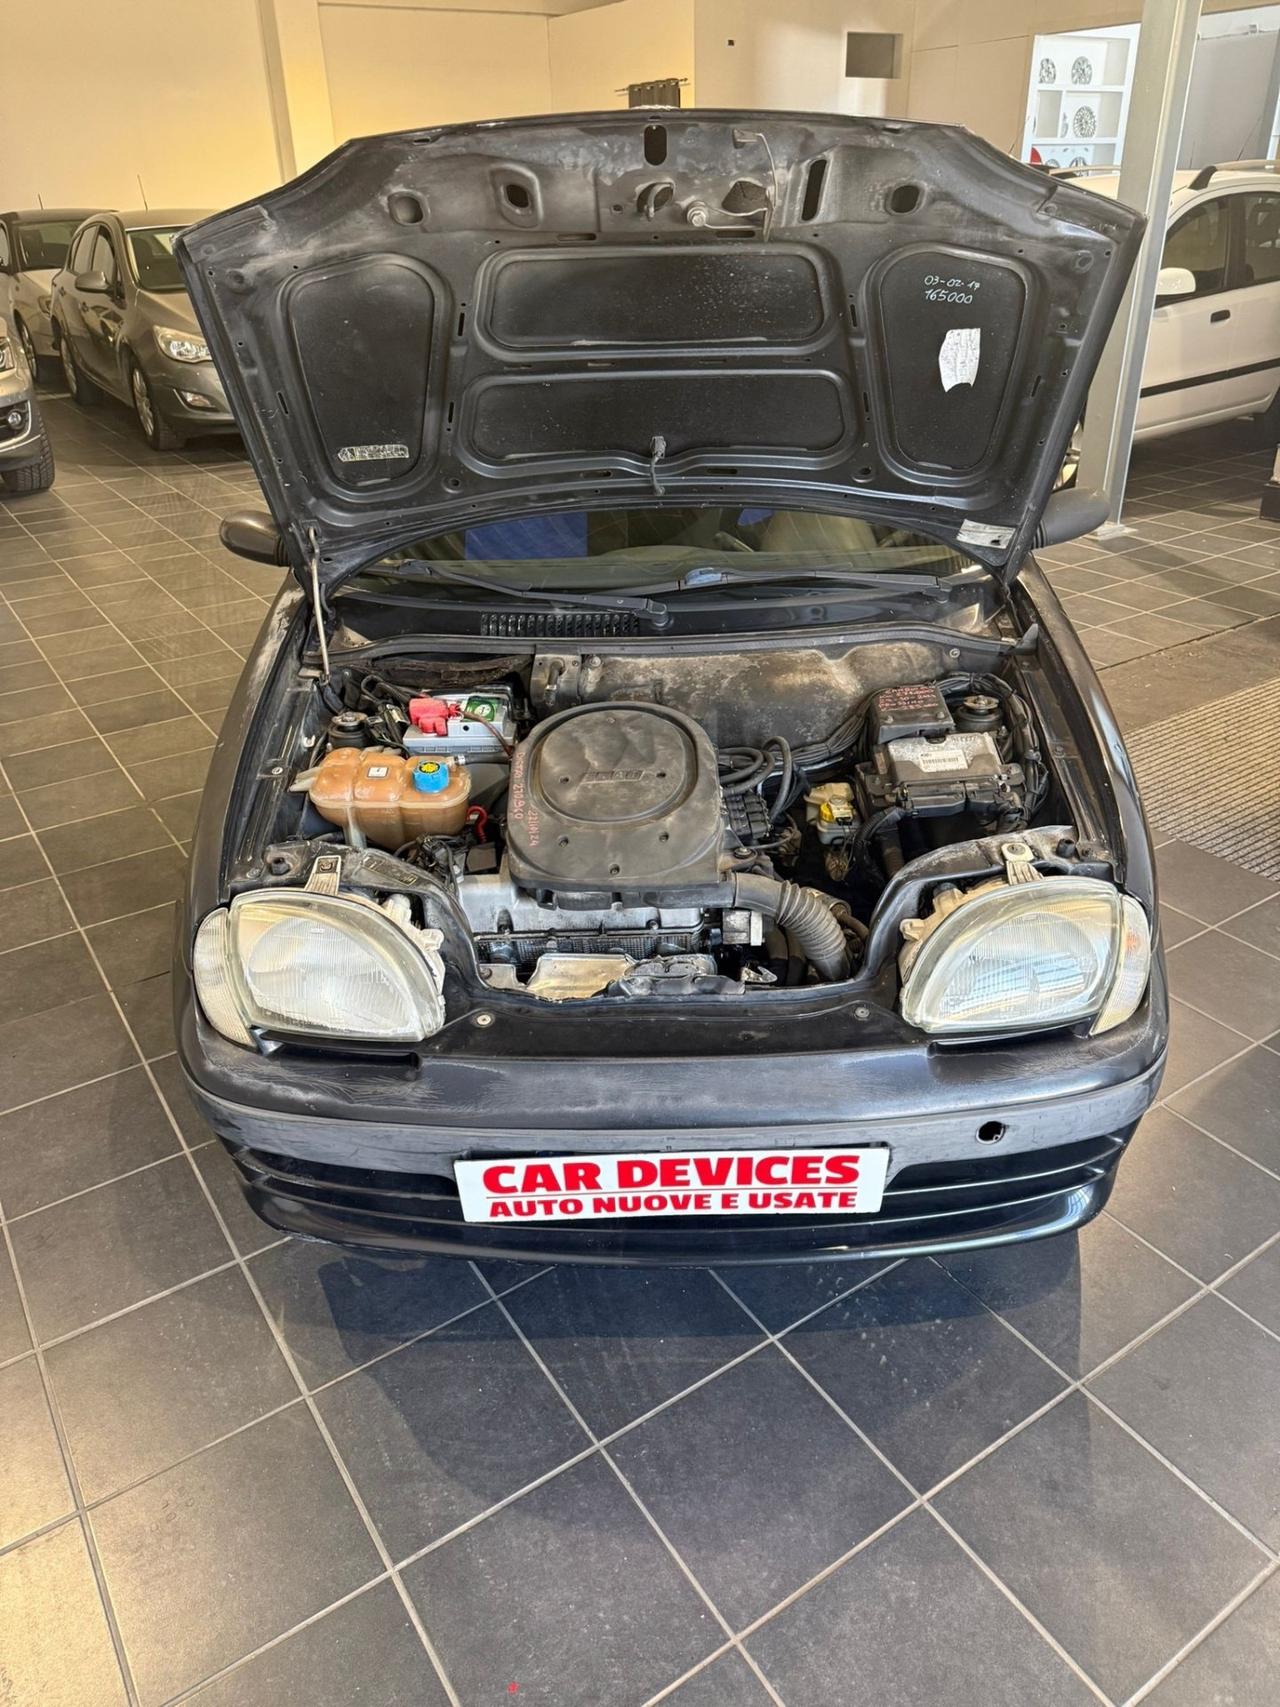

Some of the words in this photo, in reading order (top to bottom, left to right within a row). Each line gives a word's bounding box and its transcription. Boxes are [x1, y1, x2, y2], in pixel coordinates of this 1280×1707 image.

[925, 289, 973, 304] 165000
[483, 1163, 603, 1194] CAR
[617, 1155, 860, 1189] DEVICES
[489, 1198, 584, 1218] AUTO
[593, 1194, 712, 1214] NUOVE
[721, 1193, 739, 1209] E
[748, 1191, 858, 1209] USATE
